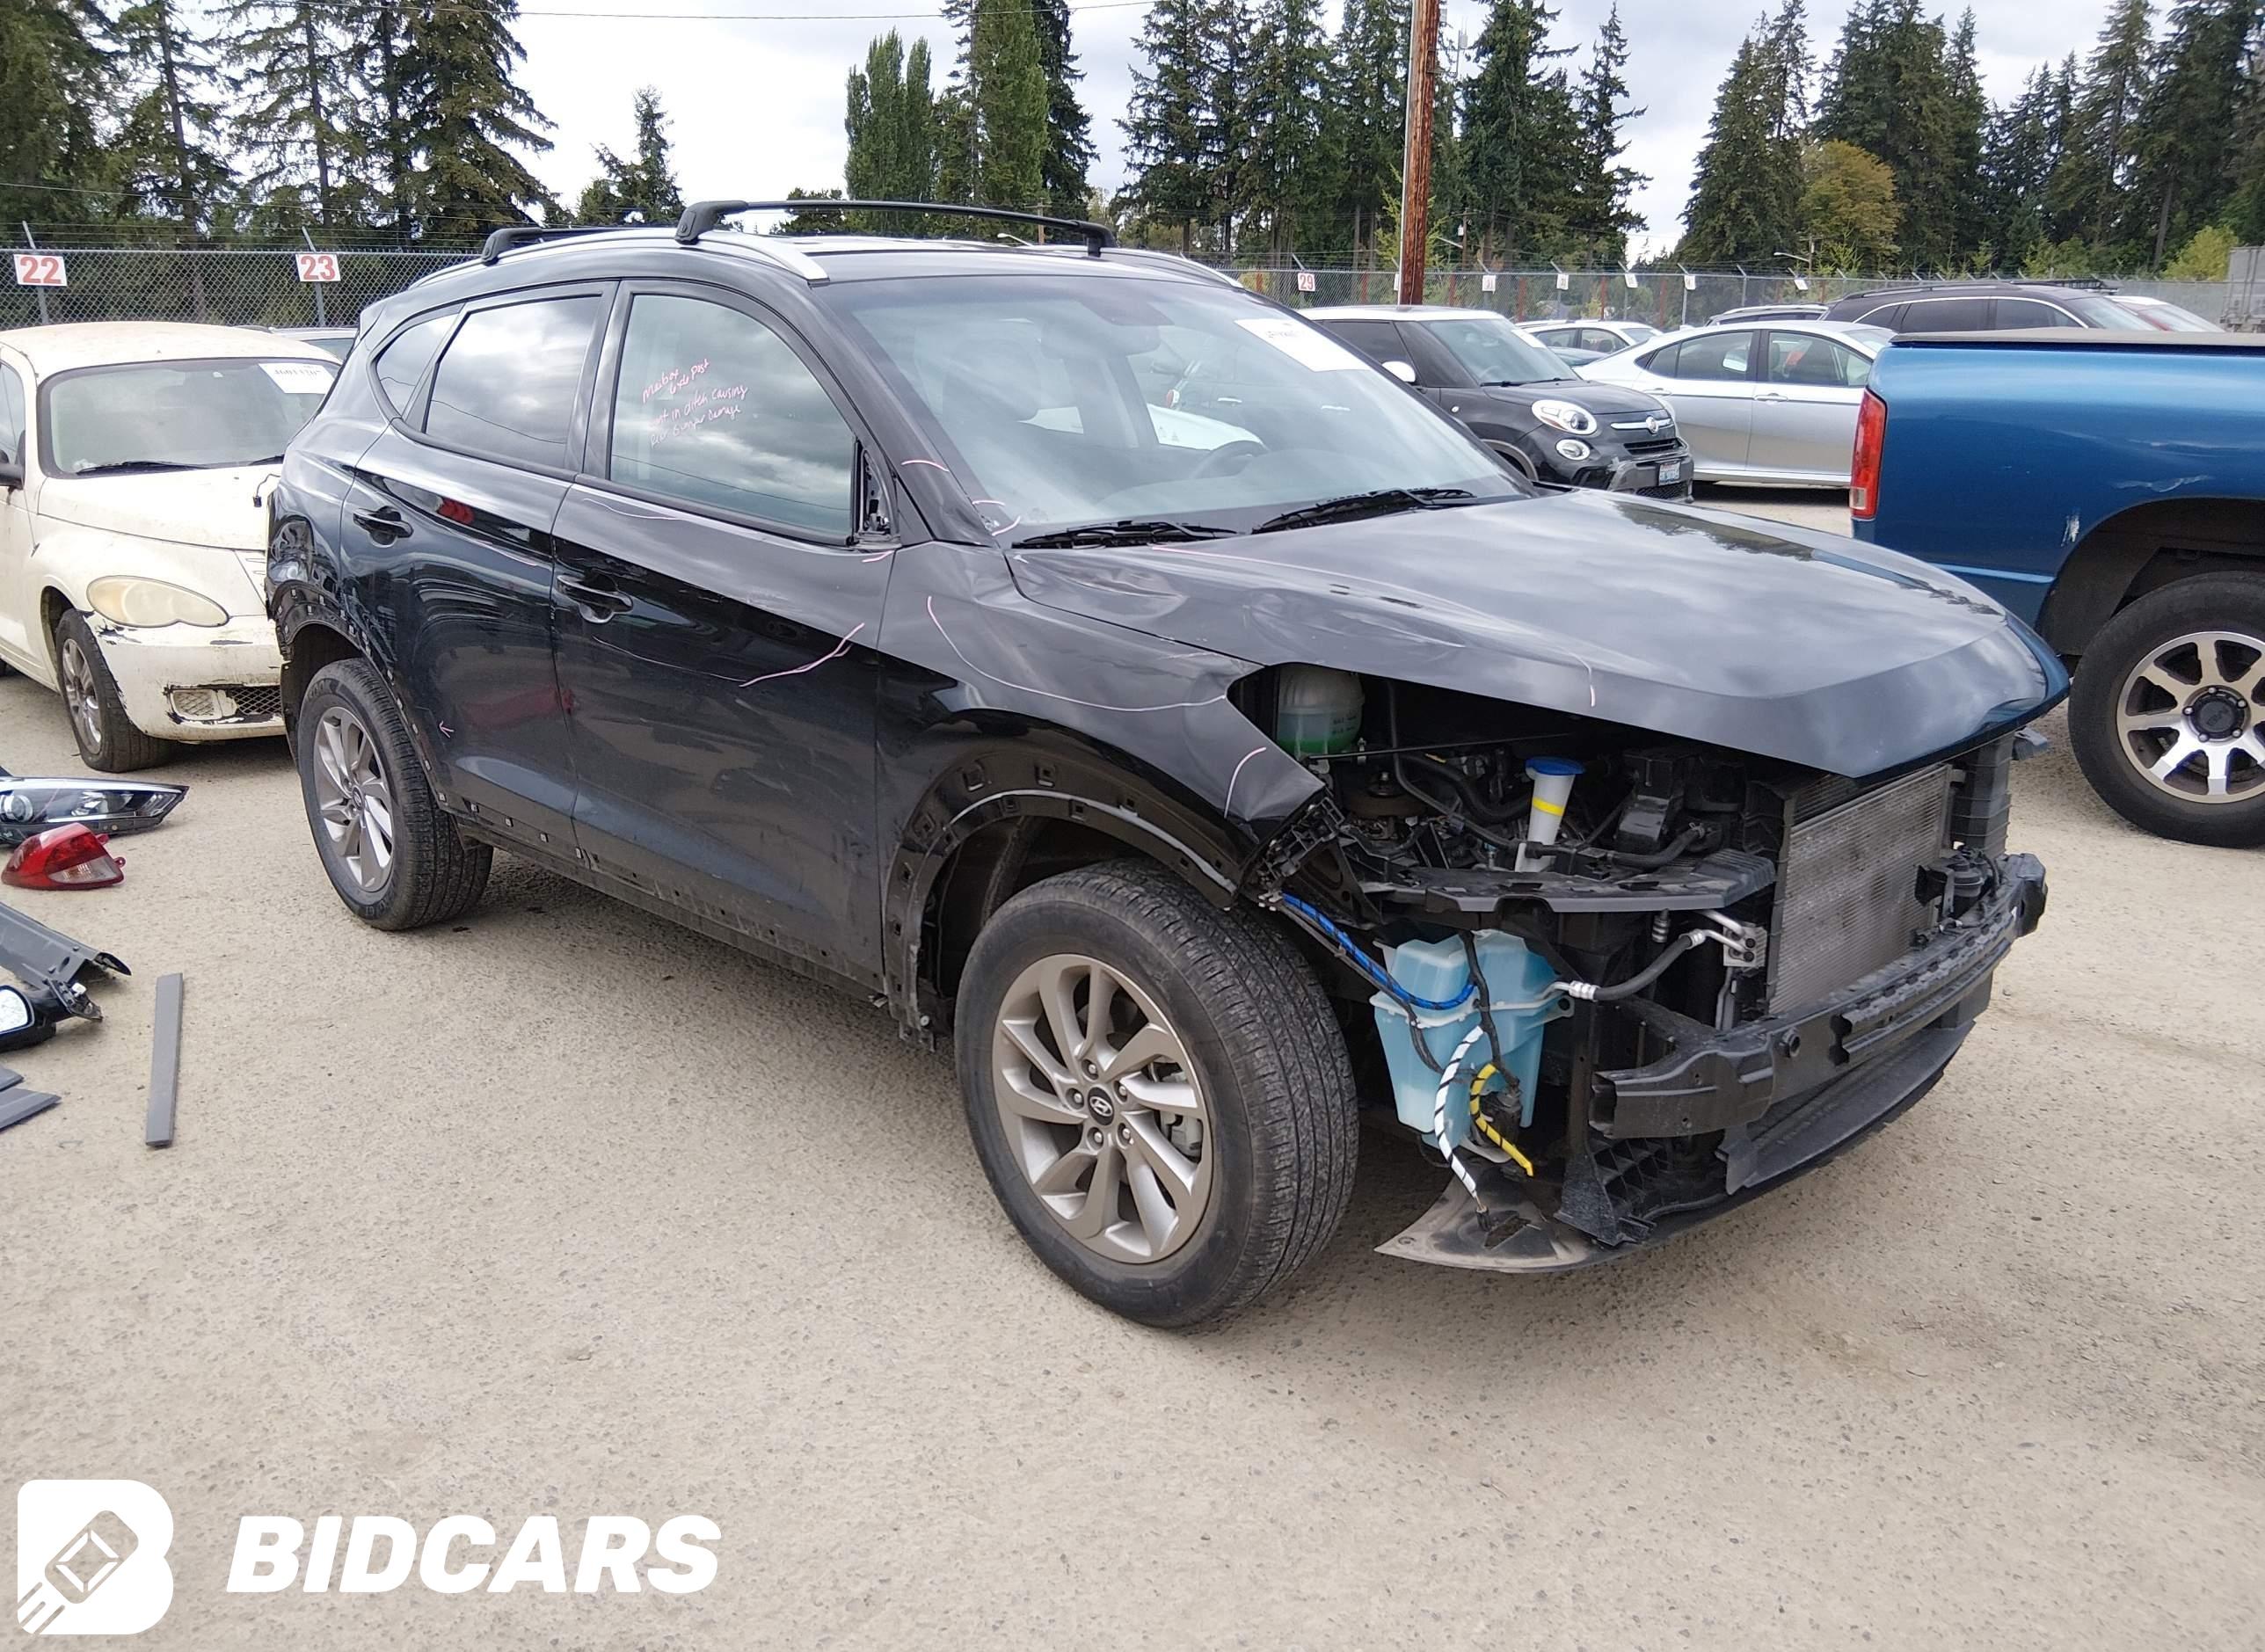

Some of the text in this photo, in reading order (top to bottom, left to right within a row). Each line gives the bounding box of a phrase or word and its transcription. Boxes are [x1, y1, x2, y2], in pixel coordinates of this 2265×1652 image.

[19, 256, 62, 284] 22
[301, 255, 336, 280] 23
[1299, 274, 1315, 290] 29
